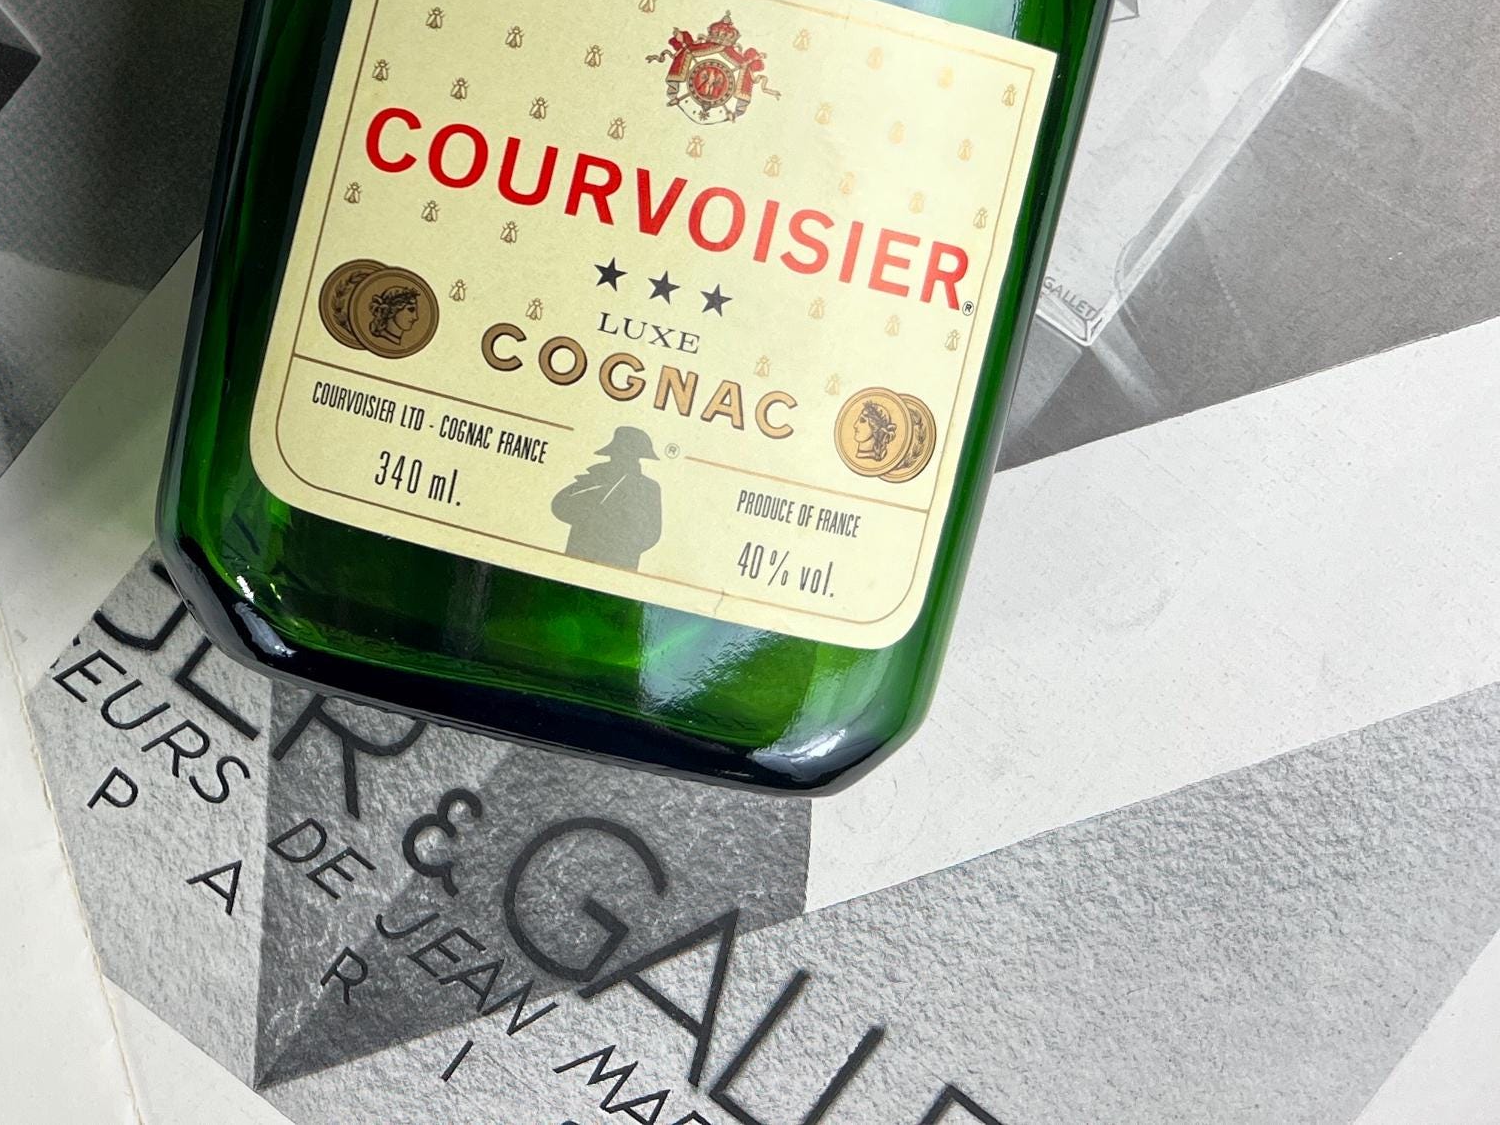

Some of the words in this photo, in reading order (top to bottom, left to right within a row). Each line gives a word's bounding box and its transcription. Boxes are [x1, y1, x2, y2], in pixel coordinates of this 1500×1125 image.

[596, 311, 700, 355] LUXE
[480, 322, 798, 440] COGNAC
[312, 381, 397, 424] COURVOISIER
[400, 404, 425, 431] LTD
[438, 414, 494, 450] COGNAC
[496, 430, 549, 464] FRANCE
[374, 450, 423, 494] 340
[427, 468, 459, 506] ml.
[736, 489, 796, 524] PRODUCE
[797, 503, 815, 528] OF
[815, 508, 862, 538] FRANCE
[799, 561, 834, 596] vol.
[268, 817, 376, 900] DE
[376, 909, 558, 1036] JEAN
